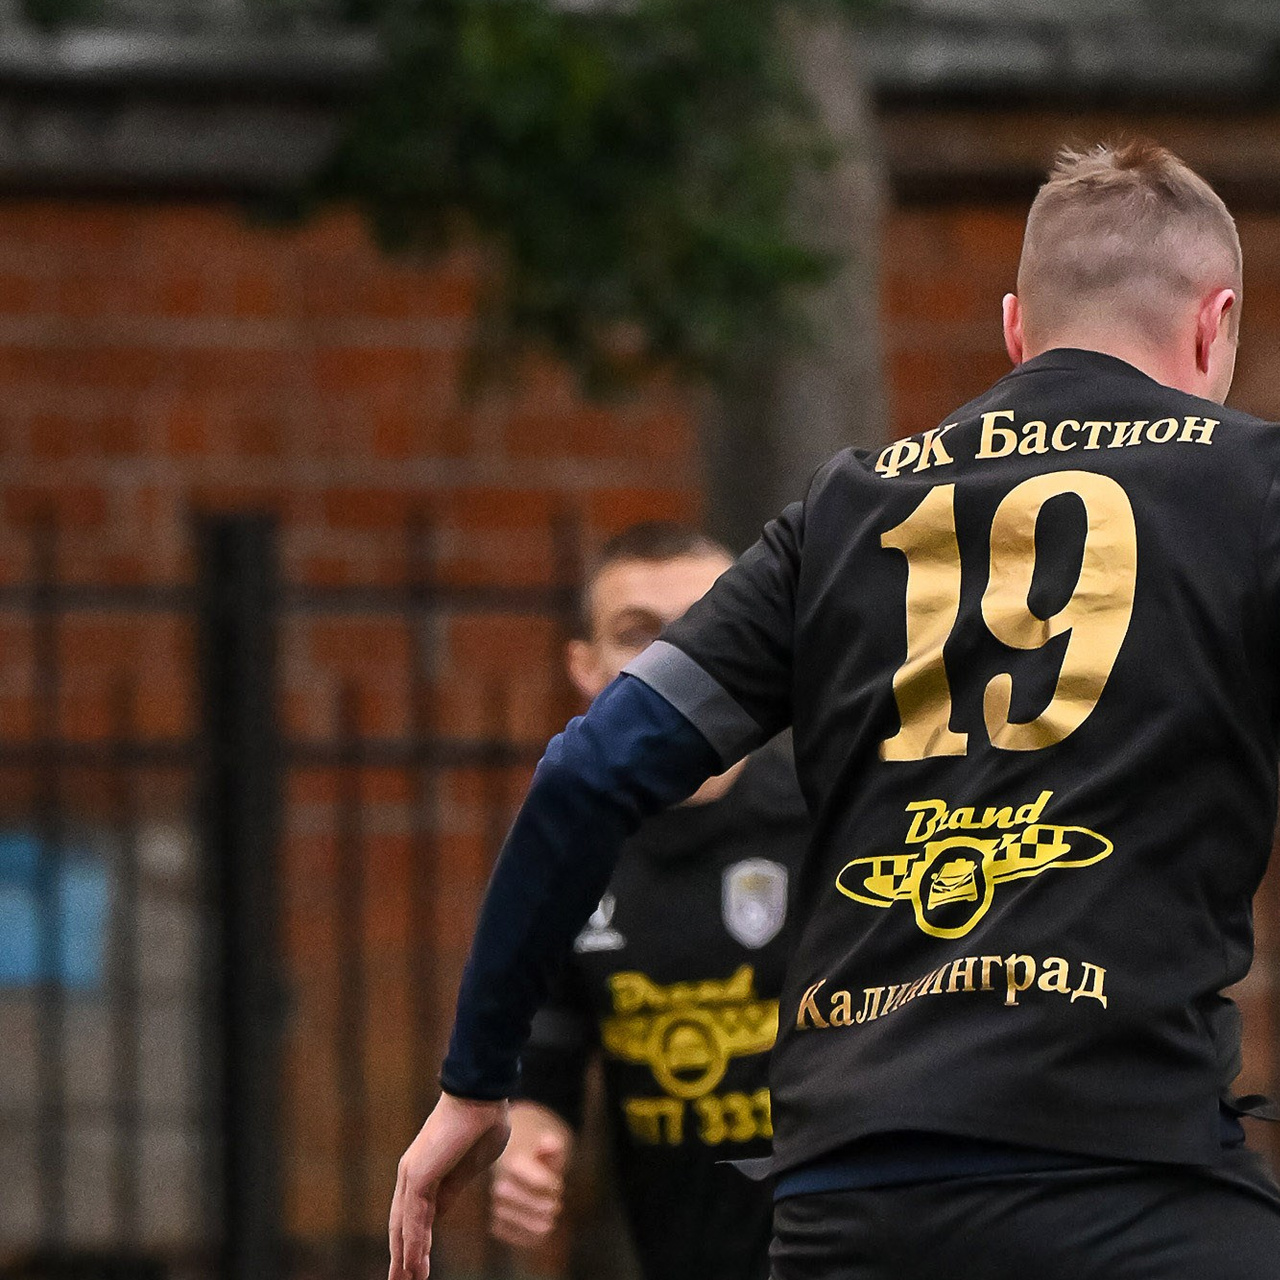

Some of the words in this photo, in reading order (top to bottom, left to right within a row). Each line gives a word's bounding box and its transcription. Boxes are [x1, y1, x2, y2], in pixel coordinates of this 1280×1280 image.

[874, 422, 958, 479] ФК
[975, 409, 1220, 459] Бастион
[879, 469, 1138, 762] 19
[904, 790, 1054, 845] Brand
[796, 953, 1108, 1031] Калининград
